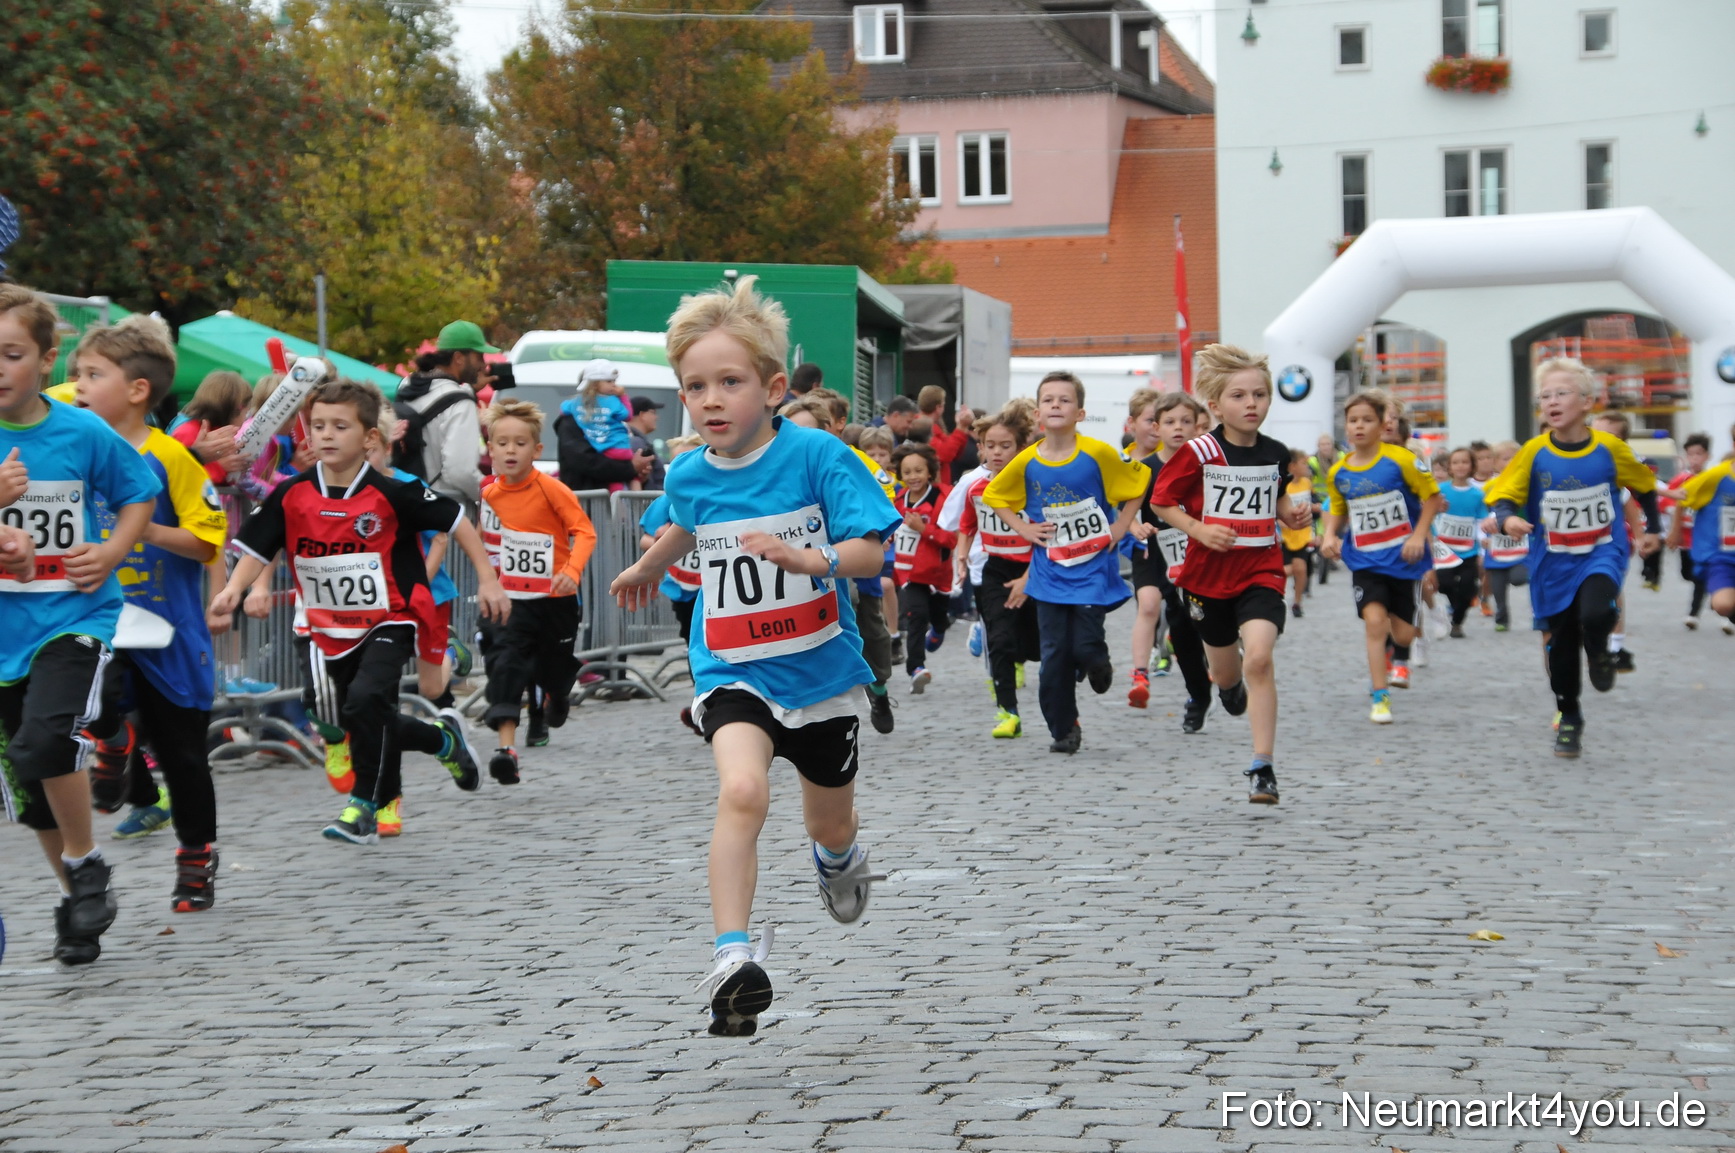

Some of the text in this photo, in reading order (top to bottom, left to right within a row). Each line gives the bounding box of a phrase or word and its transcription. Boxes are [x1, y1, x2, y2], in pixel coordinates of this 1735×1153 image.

[1205, 471, 1271, 482] PARTL Neumarkt
[18, 493, 66, 503] eumarkt
[1212, 484, 1273, 515] 7241
[1356, 504, 1403, 531] 7514
[1550, 501, 1610, 529] 7216
[509, 538, 541, 547] eumarkt
[698, 537, 733, 552] PARTL
[1067, 544, 1092, 557] Jonas
[1165, 540, 1187, 562] 75
[321, 563, 365, 574] Neumarkt
[306, 574, 377, 606] 7129
[332, 614, 362, 625] Aaron
[748, 618, 797, 639] Leon
